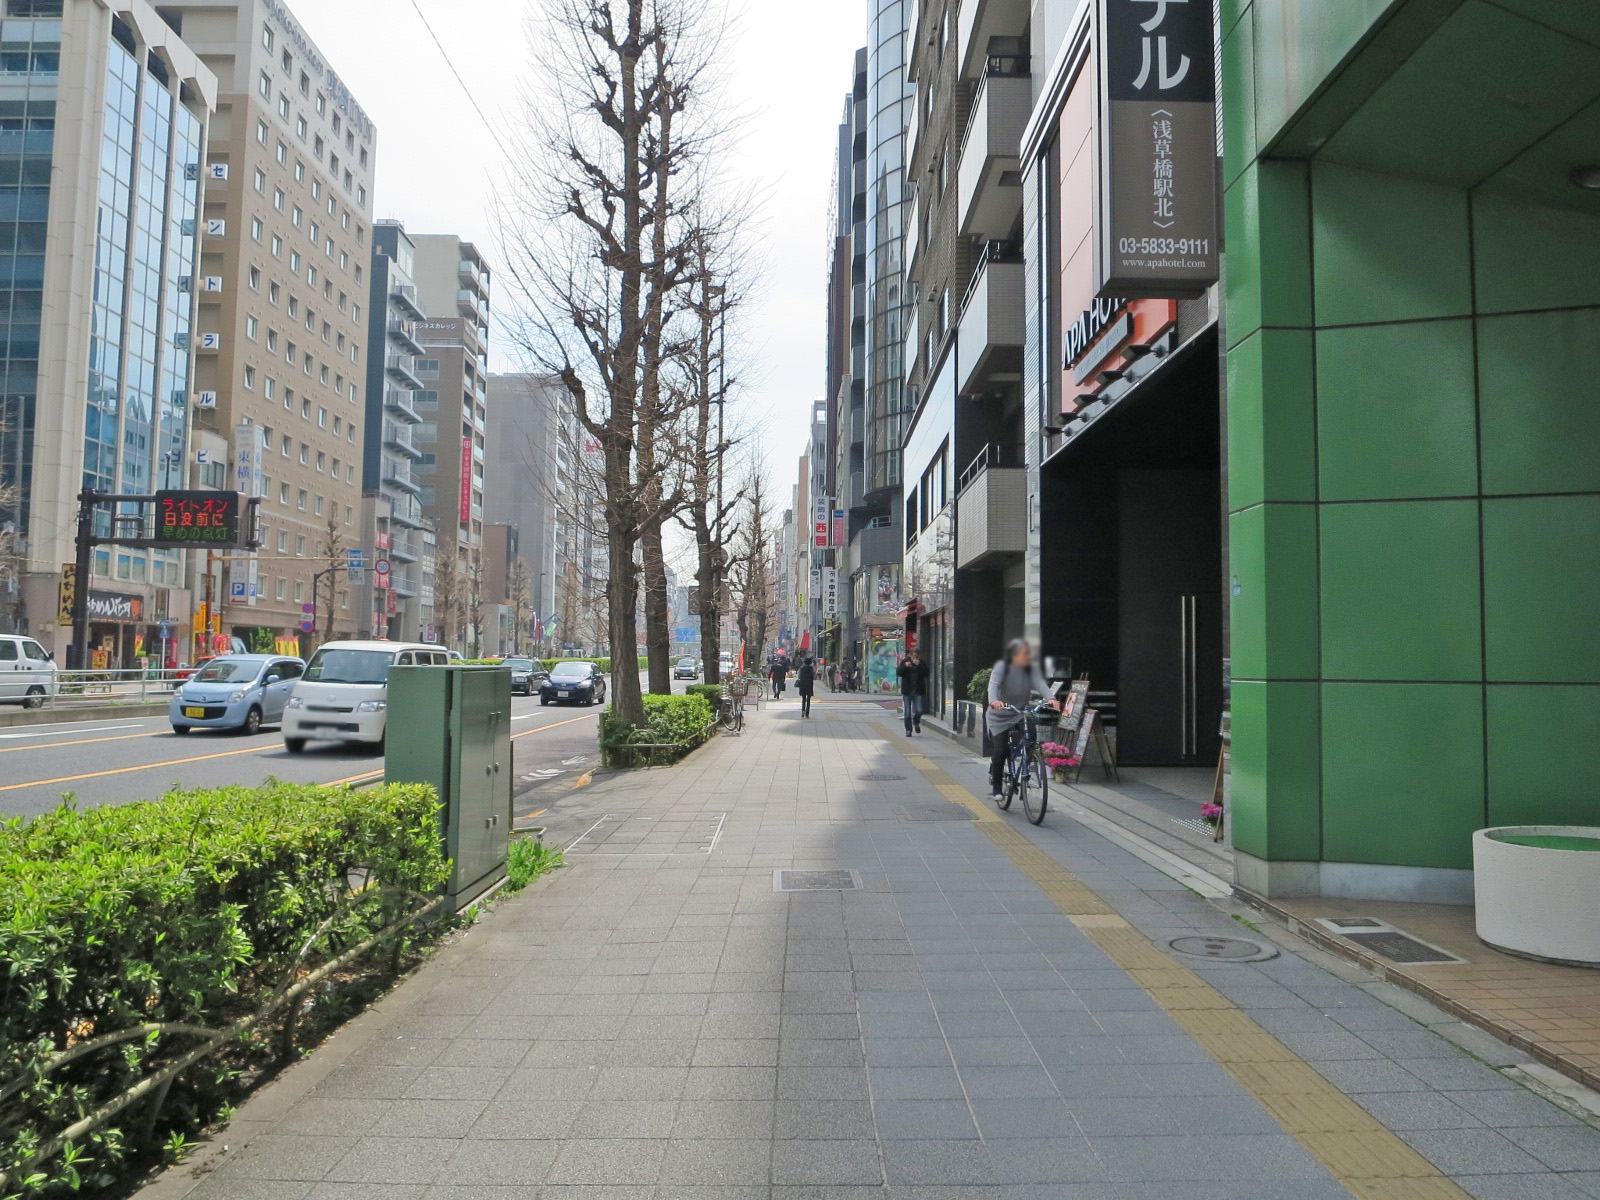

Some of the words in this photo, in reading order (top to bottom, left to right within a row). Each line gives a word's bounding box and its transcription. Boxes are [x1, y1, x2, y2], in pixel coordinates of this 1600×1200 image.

[1119, 237, 1209, 255] 03-5833-9111
[1122, 258, 1206, 269] www.apahotel.com
[162, 499, 228, 512] ライトオン
[165, 512, 224, 526] 日没前に
[162, 525, 228, 540] 早めの点灯
